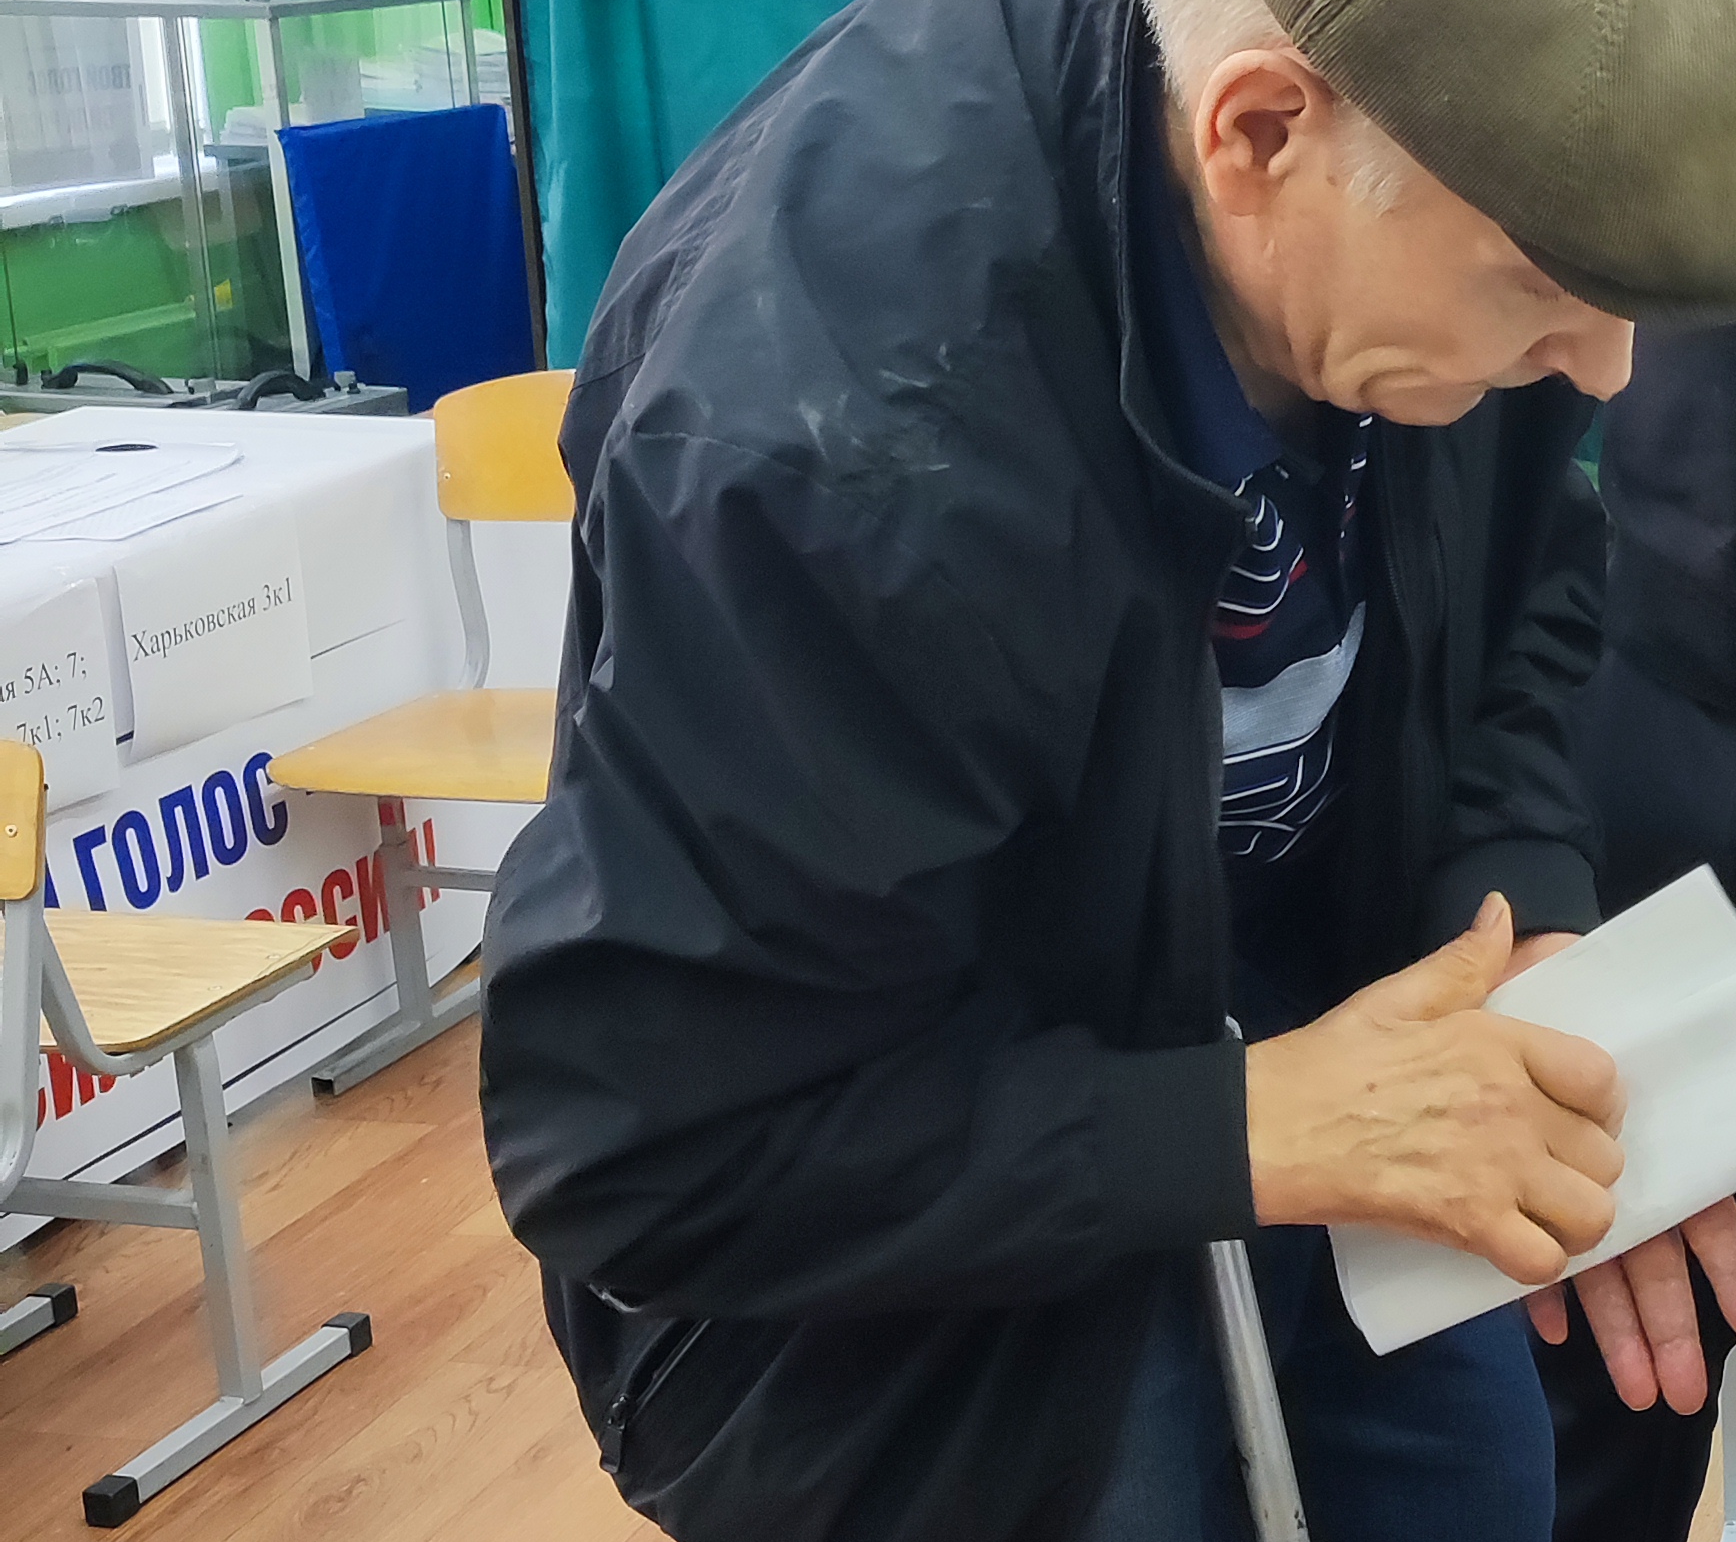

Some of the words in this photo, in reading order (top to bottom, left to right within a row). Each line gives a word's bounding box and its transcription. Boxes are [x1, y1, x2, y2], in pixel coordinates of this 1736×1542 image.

[131, 596, 257, 663] Харьковская
[262, 577, 293, 612] 3к1
[24, 661, 62, 695] 5А;
[67, 651, 88, 680] 7;
[68, 696, 105, 731] 7к2
[73, 752, 288, 912] ГОЛОС
